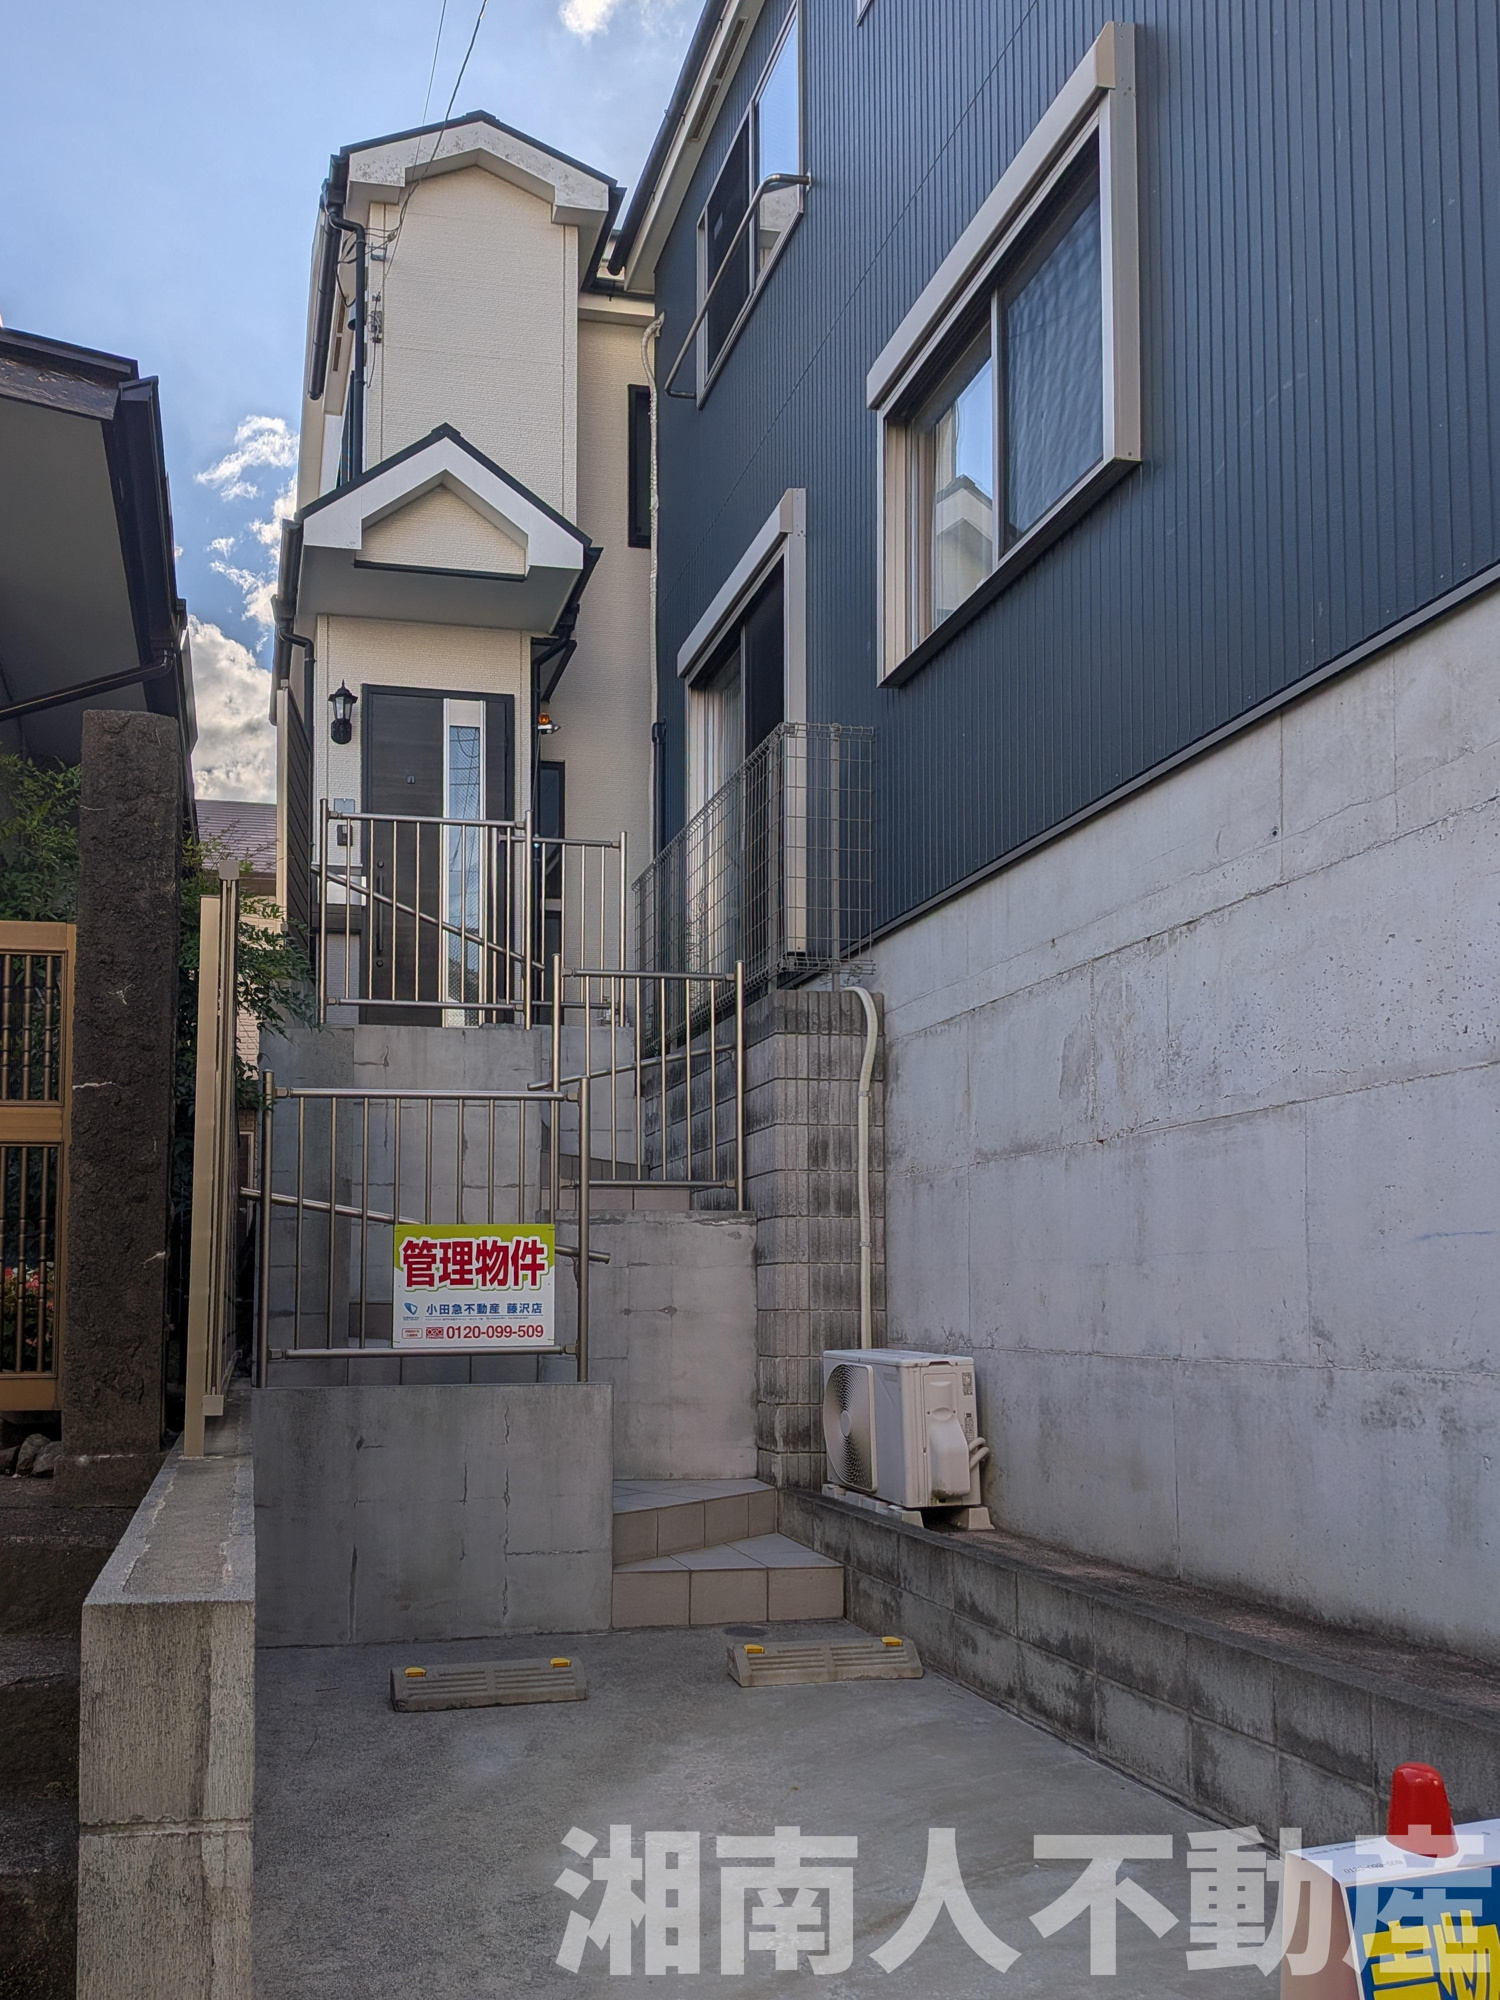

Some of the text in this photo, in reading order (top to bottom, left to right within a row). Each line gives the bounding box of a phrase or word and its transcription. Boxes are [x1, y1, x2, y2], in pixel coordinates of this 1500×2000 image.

[402, 1239, 545, 1288] 管理物件
[426, 1302, 542, 1315] 小田急不動産 藤沢店
[446, 1324, 544, 1340] 0120-099-509
